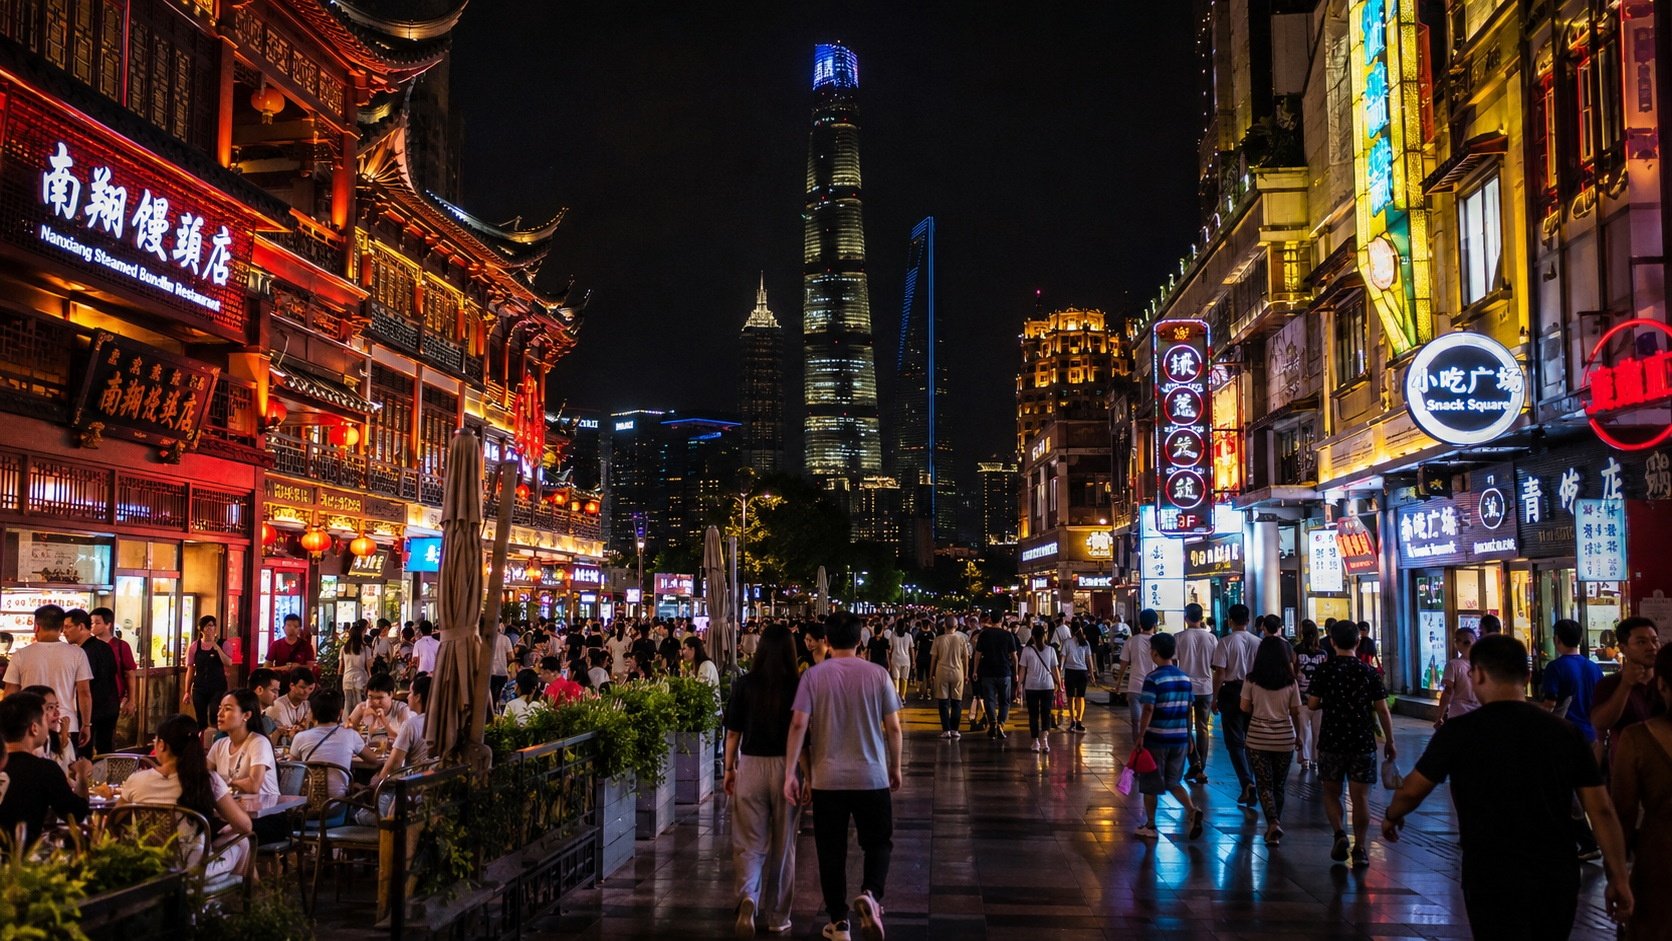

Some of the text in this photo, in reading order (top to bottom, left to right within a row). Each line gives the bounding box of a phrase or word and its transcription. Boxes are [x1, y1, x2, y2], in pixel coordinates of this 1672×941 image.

[94, 248, 138, 280] Steamed
[1411, 366, 1523, 393] 小吃广场
[1426, 398, 1511, 413] Snack Square
